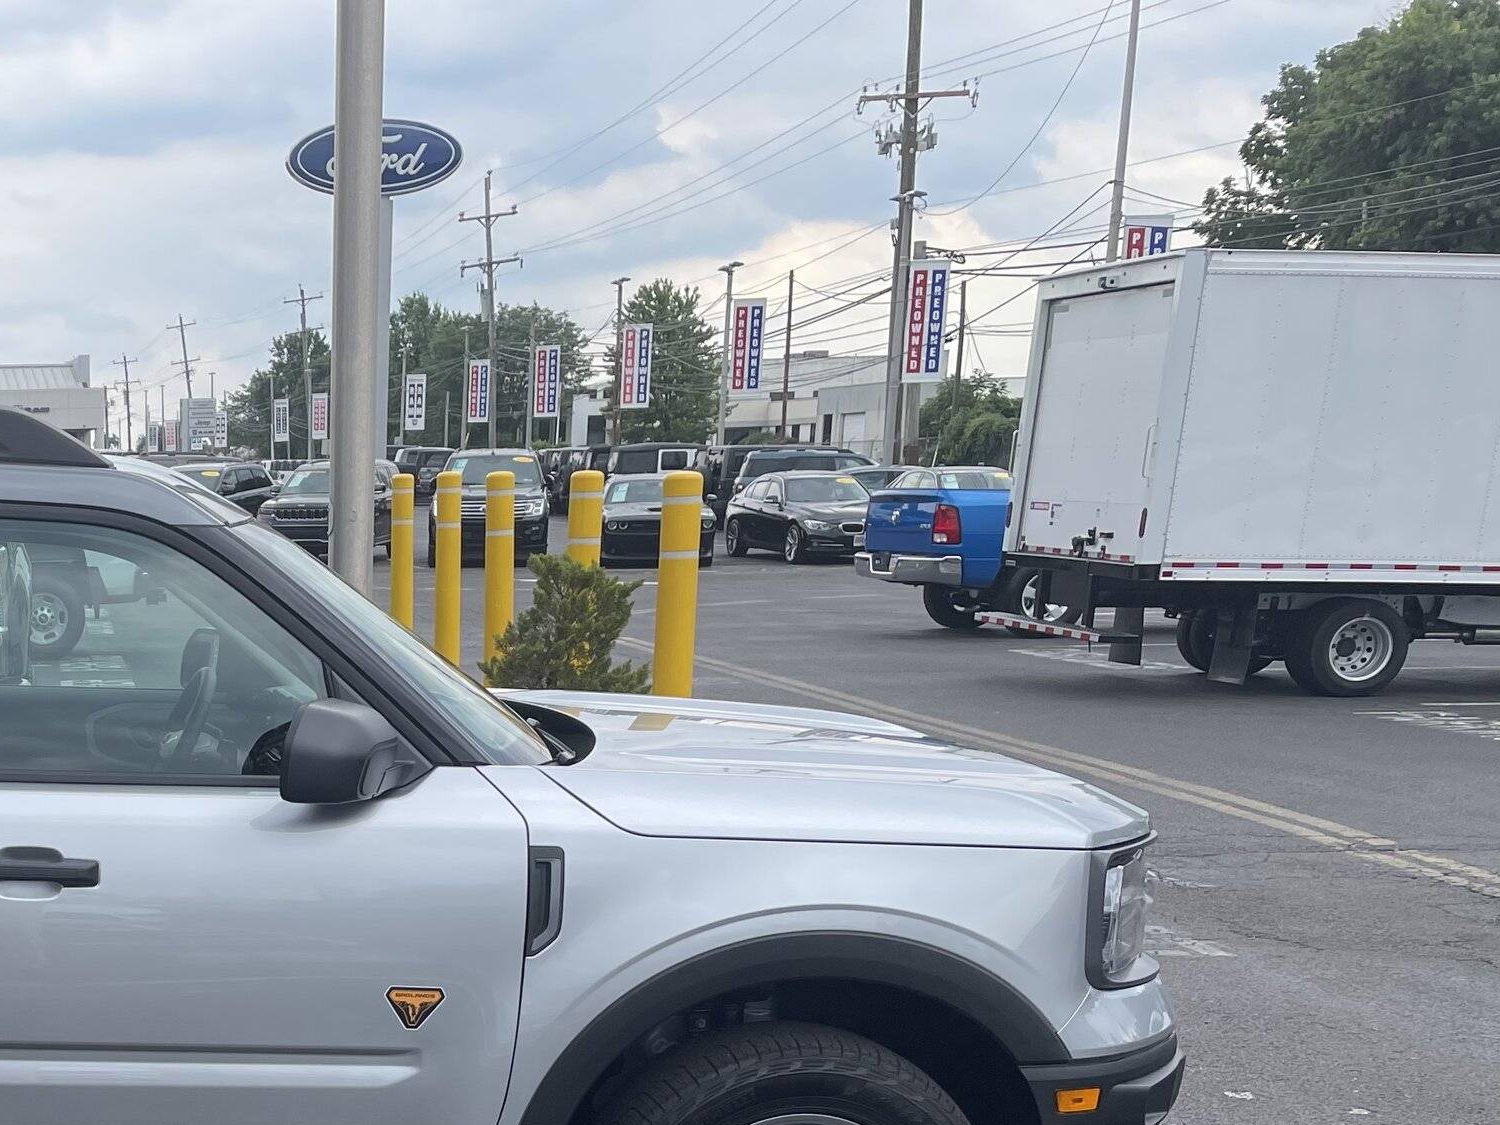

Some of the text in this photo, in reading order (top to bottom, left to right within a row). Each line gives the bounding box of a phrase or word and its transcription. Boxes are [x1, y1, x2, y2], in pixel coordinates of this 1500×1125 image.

[735, 309, 746, 387] PREOWNED
[749, 308, 760, 386] PREOWNED
[910, 273, 924, 370] PREOWNED
[928, 273, 943, 370] PREOWNED
